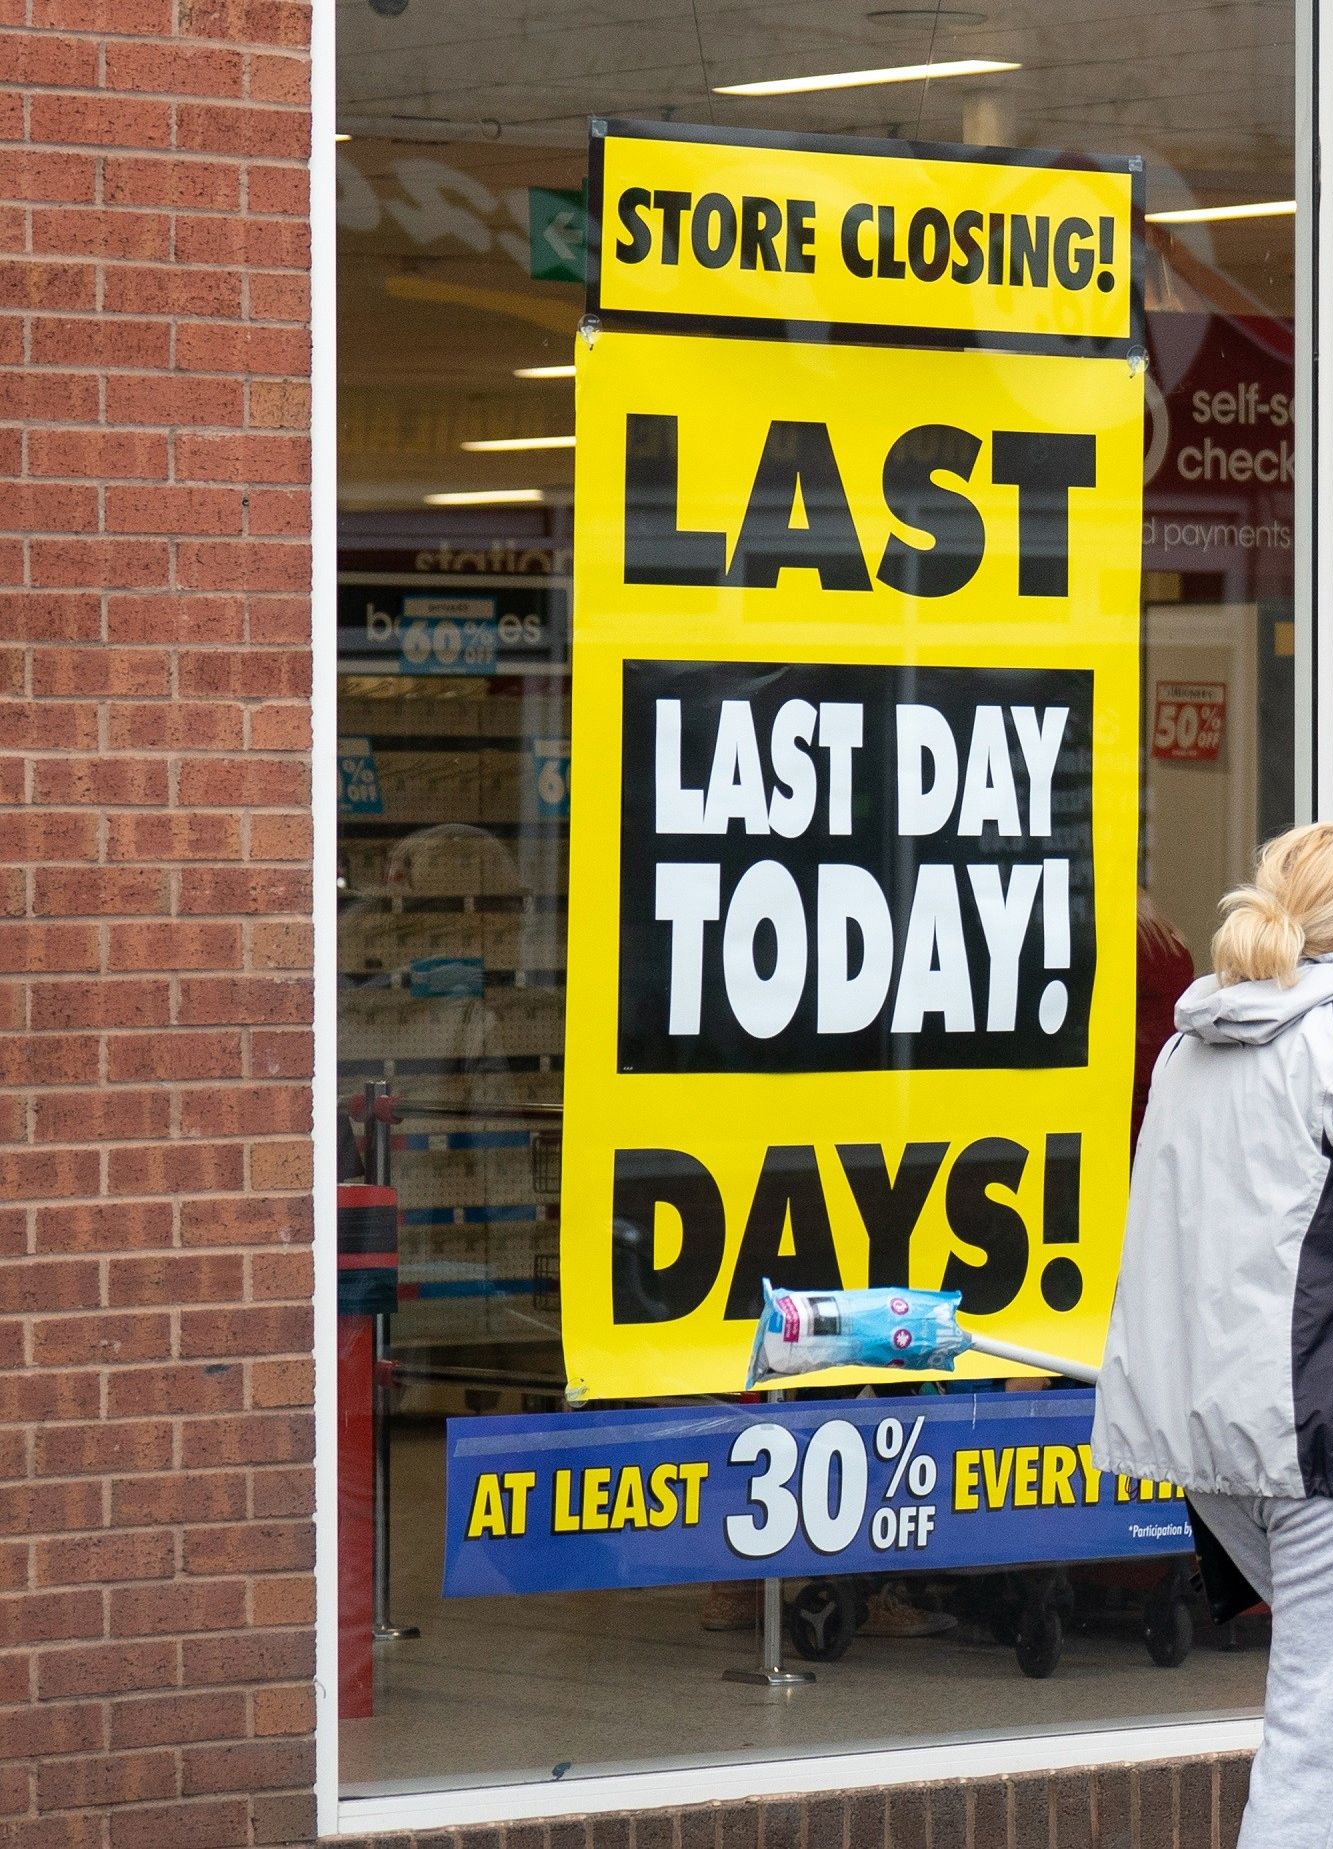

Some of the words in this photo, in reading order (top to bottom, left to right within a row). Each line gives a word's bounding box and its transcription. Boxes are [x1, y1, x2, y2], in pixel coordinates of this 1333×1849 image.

[615, 187, 816, 274] STORE
[841, 203, 1115, 293] CLOSING!
[623, 413, 1097, 598] LAST
[1164, 519, 1291, 551] payments
[655, 698, 864, 839] LAST
[895, 704, 1070, 837] DAY
[655, 858, 1071, 1039] TODAY!
[611, 1132, 1083, 1326] DAYS!
[467, 1472, 537, 1539] AT
[553, 1463, 709, 1533] LEAST
[872, 1506, 936, 1549] OFF
